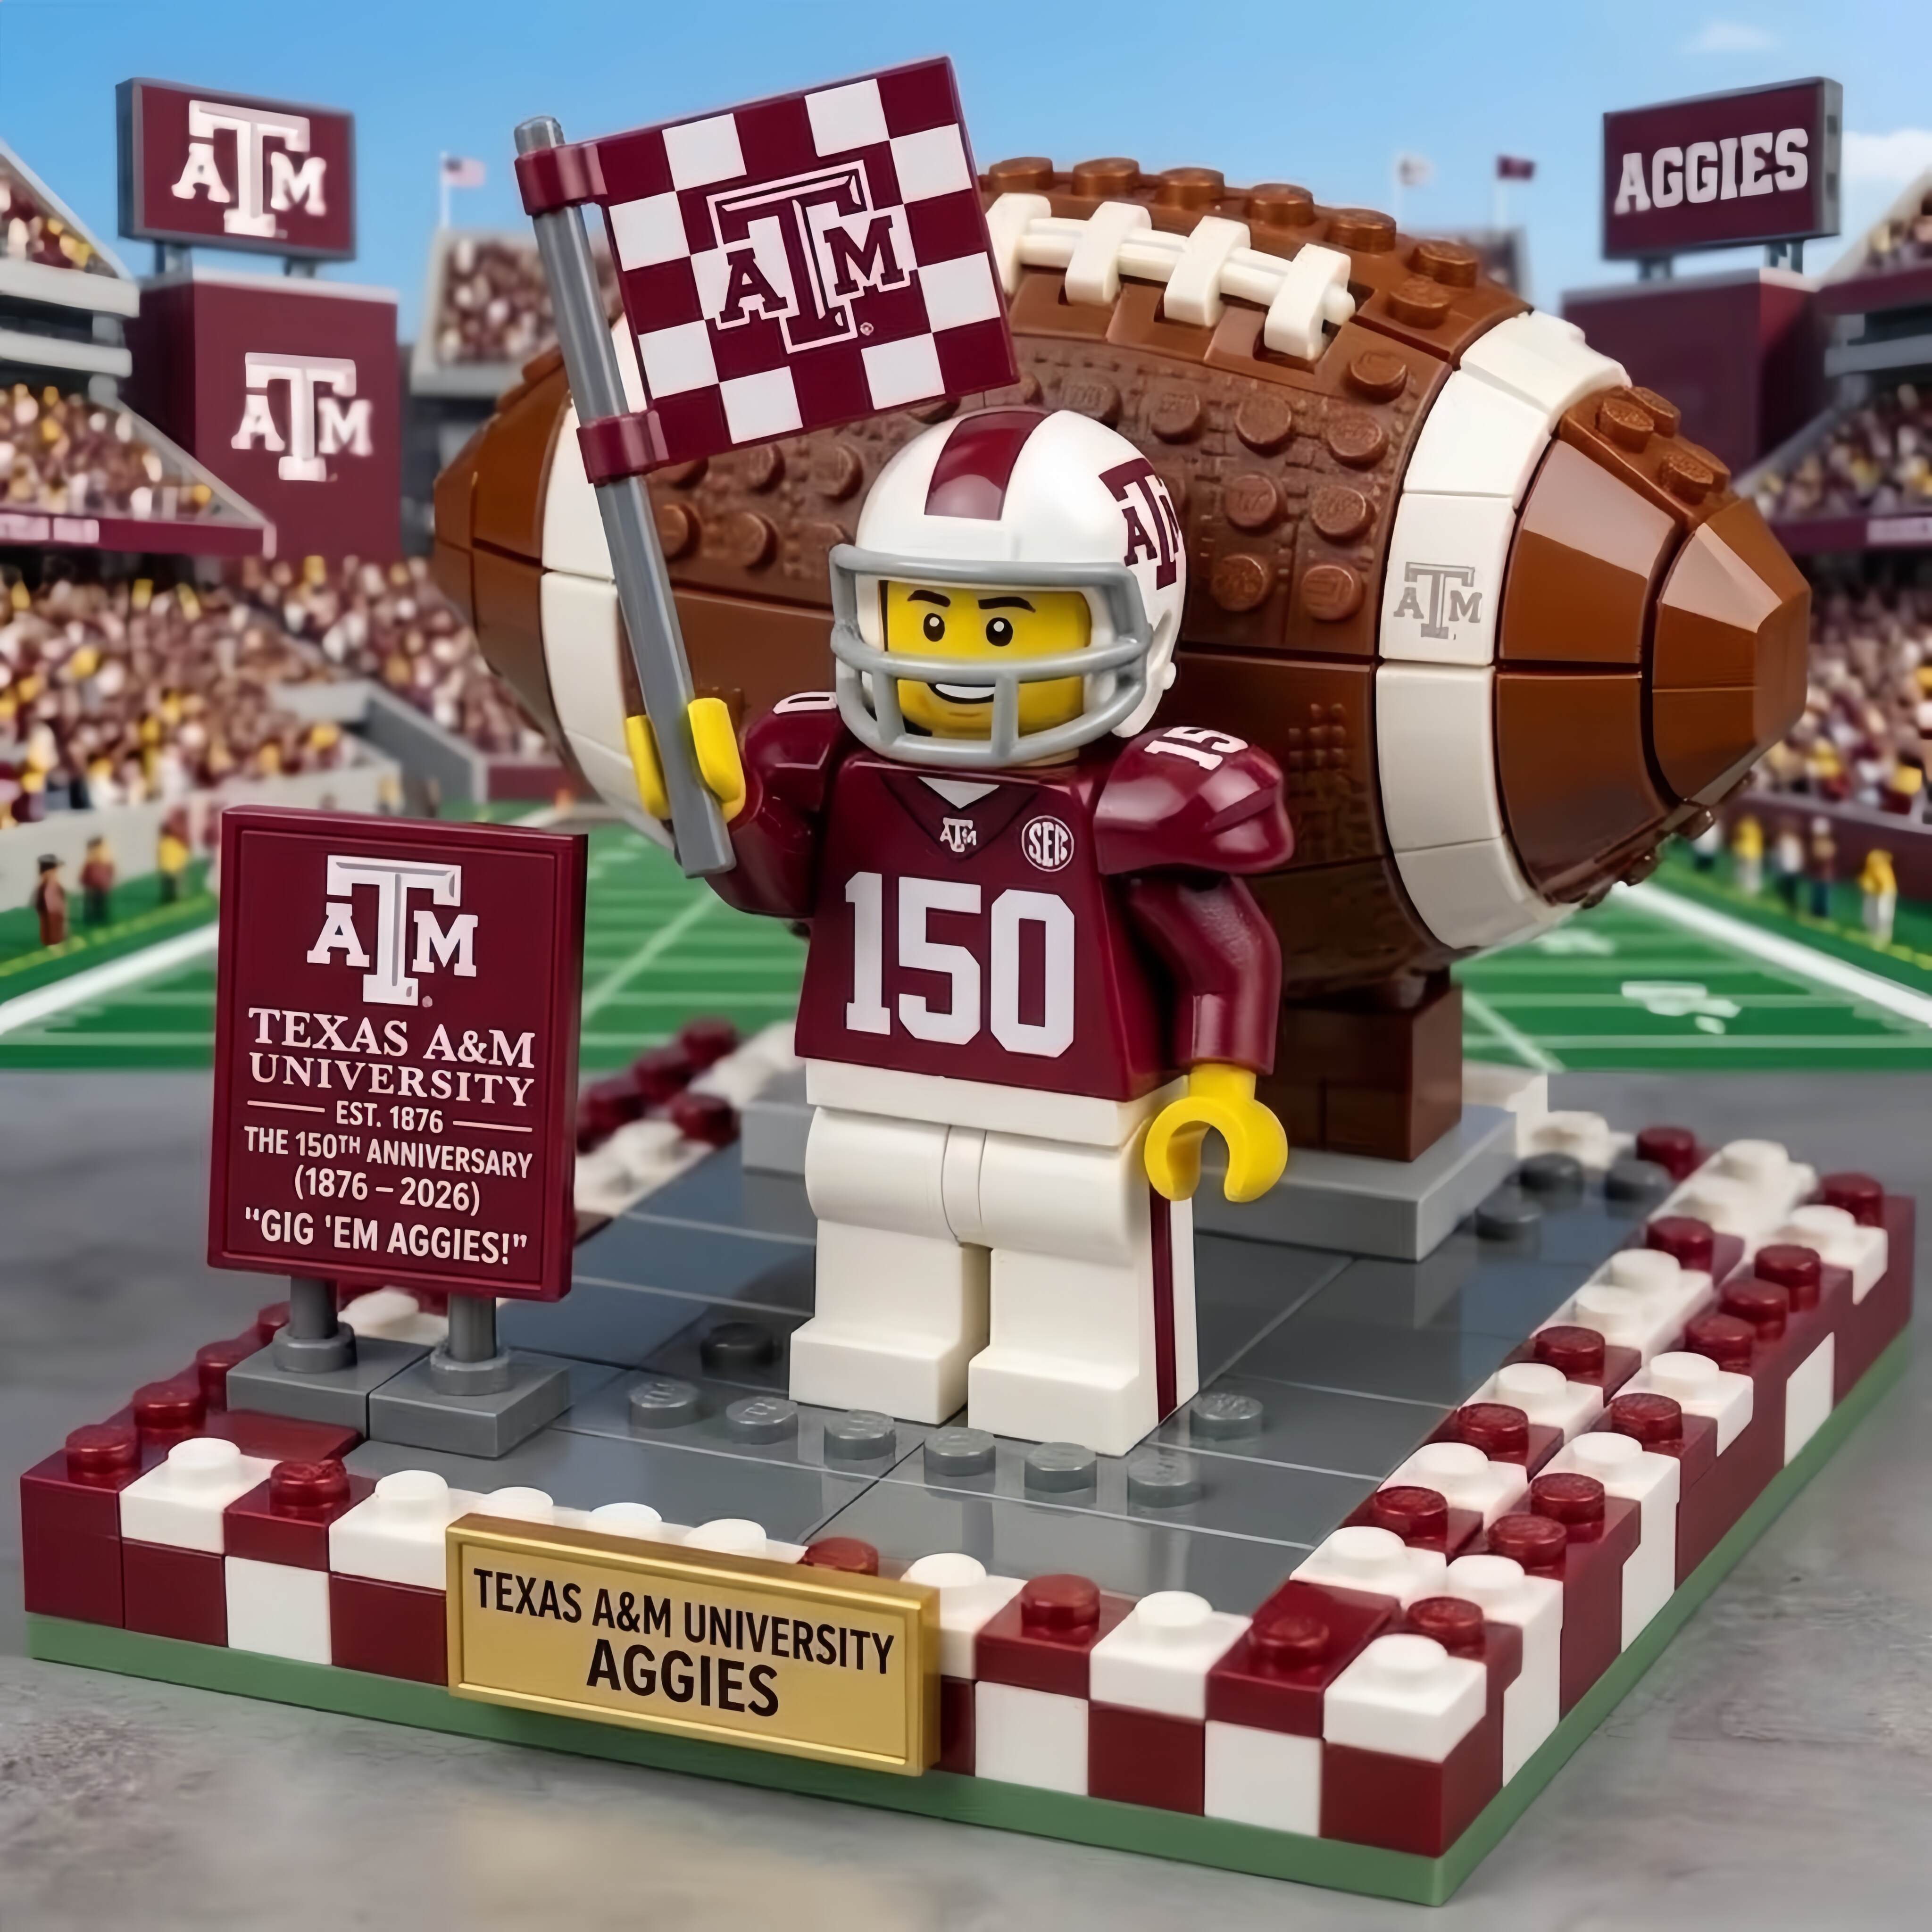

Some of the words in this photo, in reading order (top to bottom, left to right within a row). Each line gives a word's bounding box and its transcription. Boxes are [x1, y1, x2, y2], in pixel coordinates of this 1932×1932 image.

[1614, 127, 1809, 215] AGGIES
[845, 871, 1075, 1058] 150
[248, 1007, 408, 1057] TEXAS
[422, 1023, 536, 1069] A&M
[249, 1051, 535, 1107] UNIVERSITY
[243, 1125, 289, 1155] THE
[366, 1138, 533, 1179] ANNIVERSARY
[336, 1100, 382, 1128] EST.
[389, 1105, 443, 1134] 1876
[473, 1567, 582, 1624] TEXAS
[591, 1588, 671, 1638] A&M
[684, 1601, 895, 1675] UNIVERSITY
[586, 1638, 779, 1717] AGGIES
